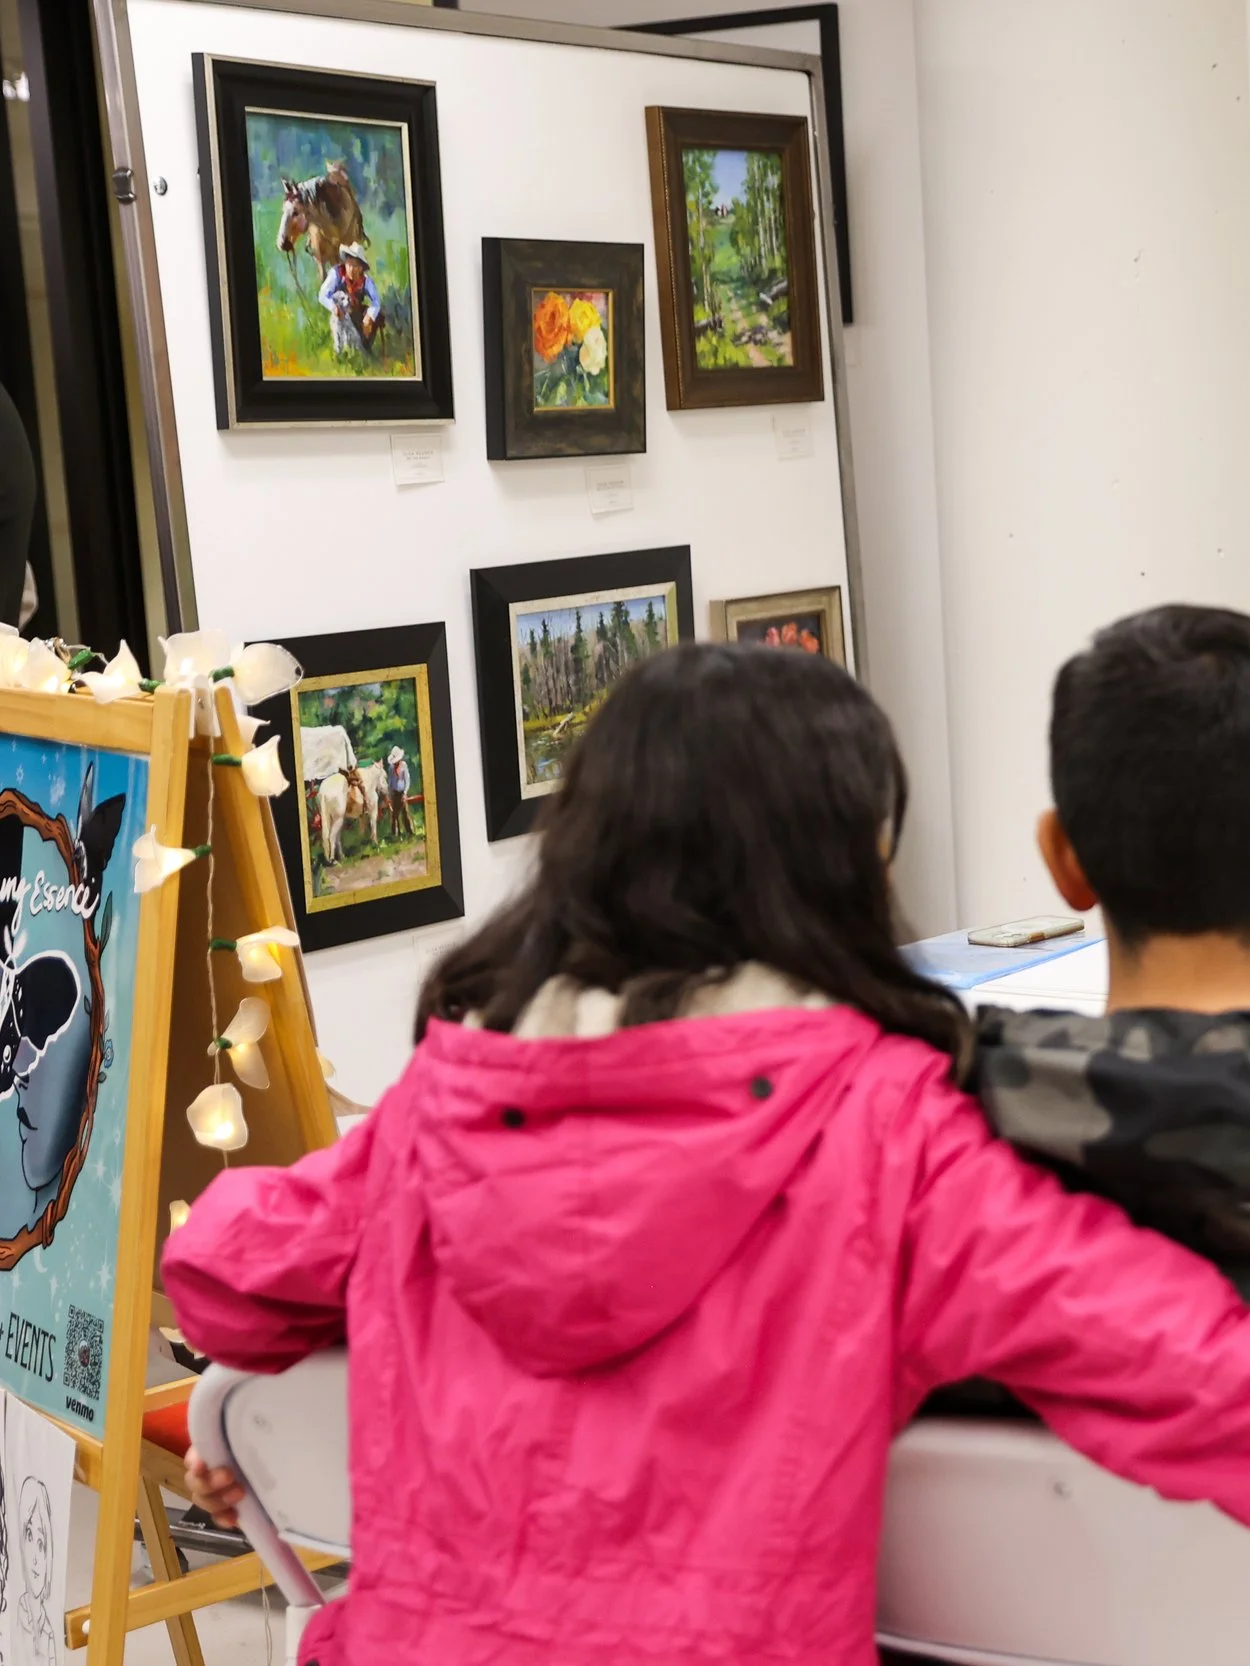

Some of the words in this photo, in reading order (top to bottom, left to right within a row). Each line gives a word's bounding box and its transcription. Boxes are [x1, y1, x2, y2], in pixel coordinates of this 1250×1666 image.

[30, 869, 99, 919] Essence
[5, 1311, 56, 1382] EVENTS
[65, 1395, 94, 1421] venmo
